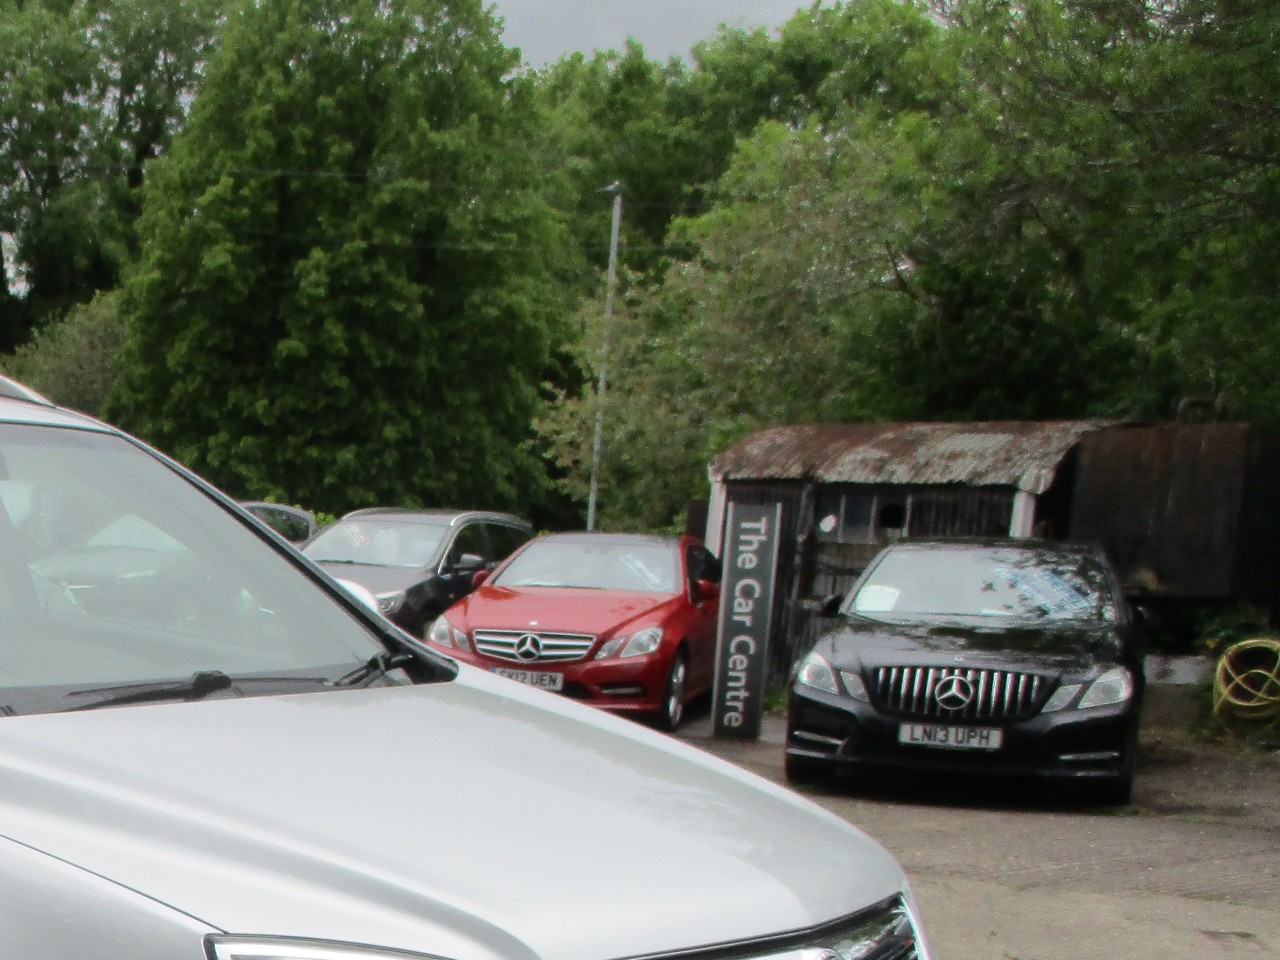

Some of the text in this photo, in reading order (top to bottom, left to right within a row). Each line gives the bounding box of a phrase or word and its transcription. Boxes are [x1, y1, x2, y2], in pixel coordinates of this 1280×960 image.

[723, 515, 768, 729] The Car Centre
[910, 723, 990, 746] LN13 UPH
